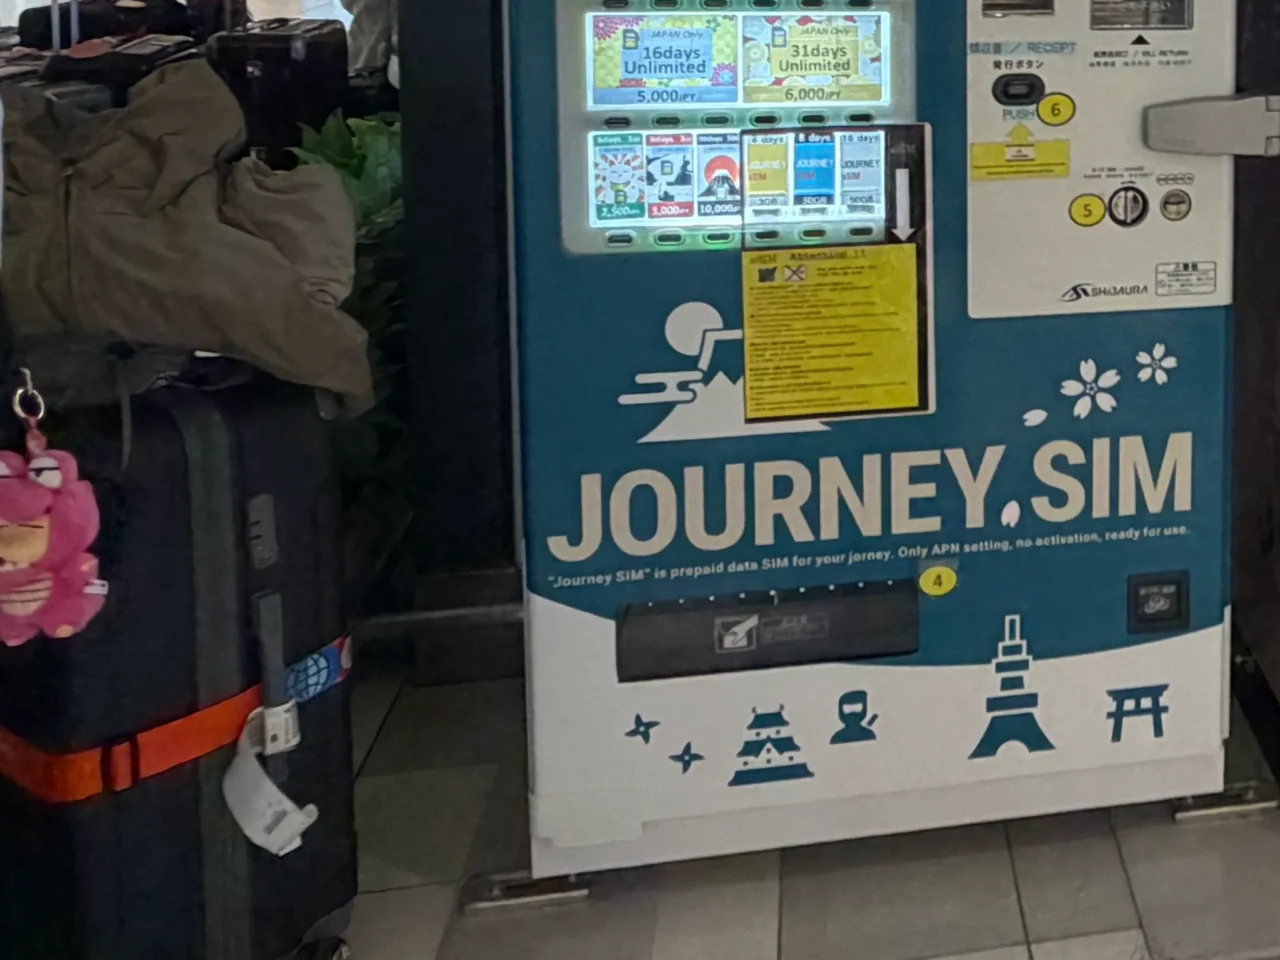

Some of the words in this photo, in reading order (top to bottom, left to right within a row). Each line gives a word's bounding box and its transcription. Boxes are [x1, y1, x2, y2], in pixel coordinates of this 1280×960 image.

[799, 26, 828, 36] JAPAN
[642, 46, 701, 61] 16days
[790, 44, 848, 59] 31days
[1027, 42, 1077, 54] RECEIPT
[623, 58, 708, 76] Unlimited
[778, 56, 850, 72] Unlimited
[993, 59, 1044, 70] 発行ボタン
[1002, 109, 1036, 121] PUSH
[1051, 103, 1061, 117] 6
[1083, 204, 1093, 218] 5
[546, 444, 1006, 562] JOURNEY
[1029, 431, 1194, 523] SIM
[654, 566, 667, 579] is
[670, 561, 724, 580] prepaid
[727, 559, 758, 573] data
[761, 556, 789, 570] SIM
[792, 555, 813, 568] for
[815, 552, 846, 568] your
[897, 545, 929, 560] Only
[931, 541, 960, 556] APN
[1016, 536, 1033, 548] no
[1105, 528, 1141, 542] ready
[1143, 526, 1161, 539] for
[932, 574, 944, 589] 4
